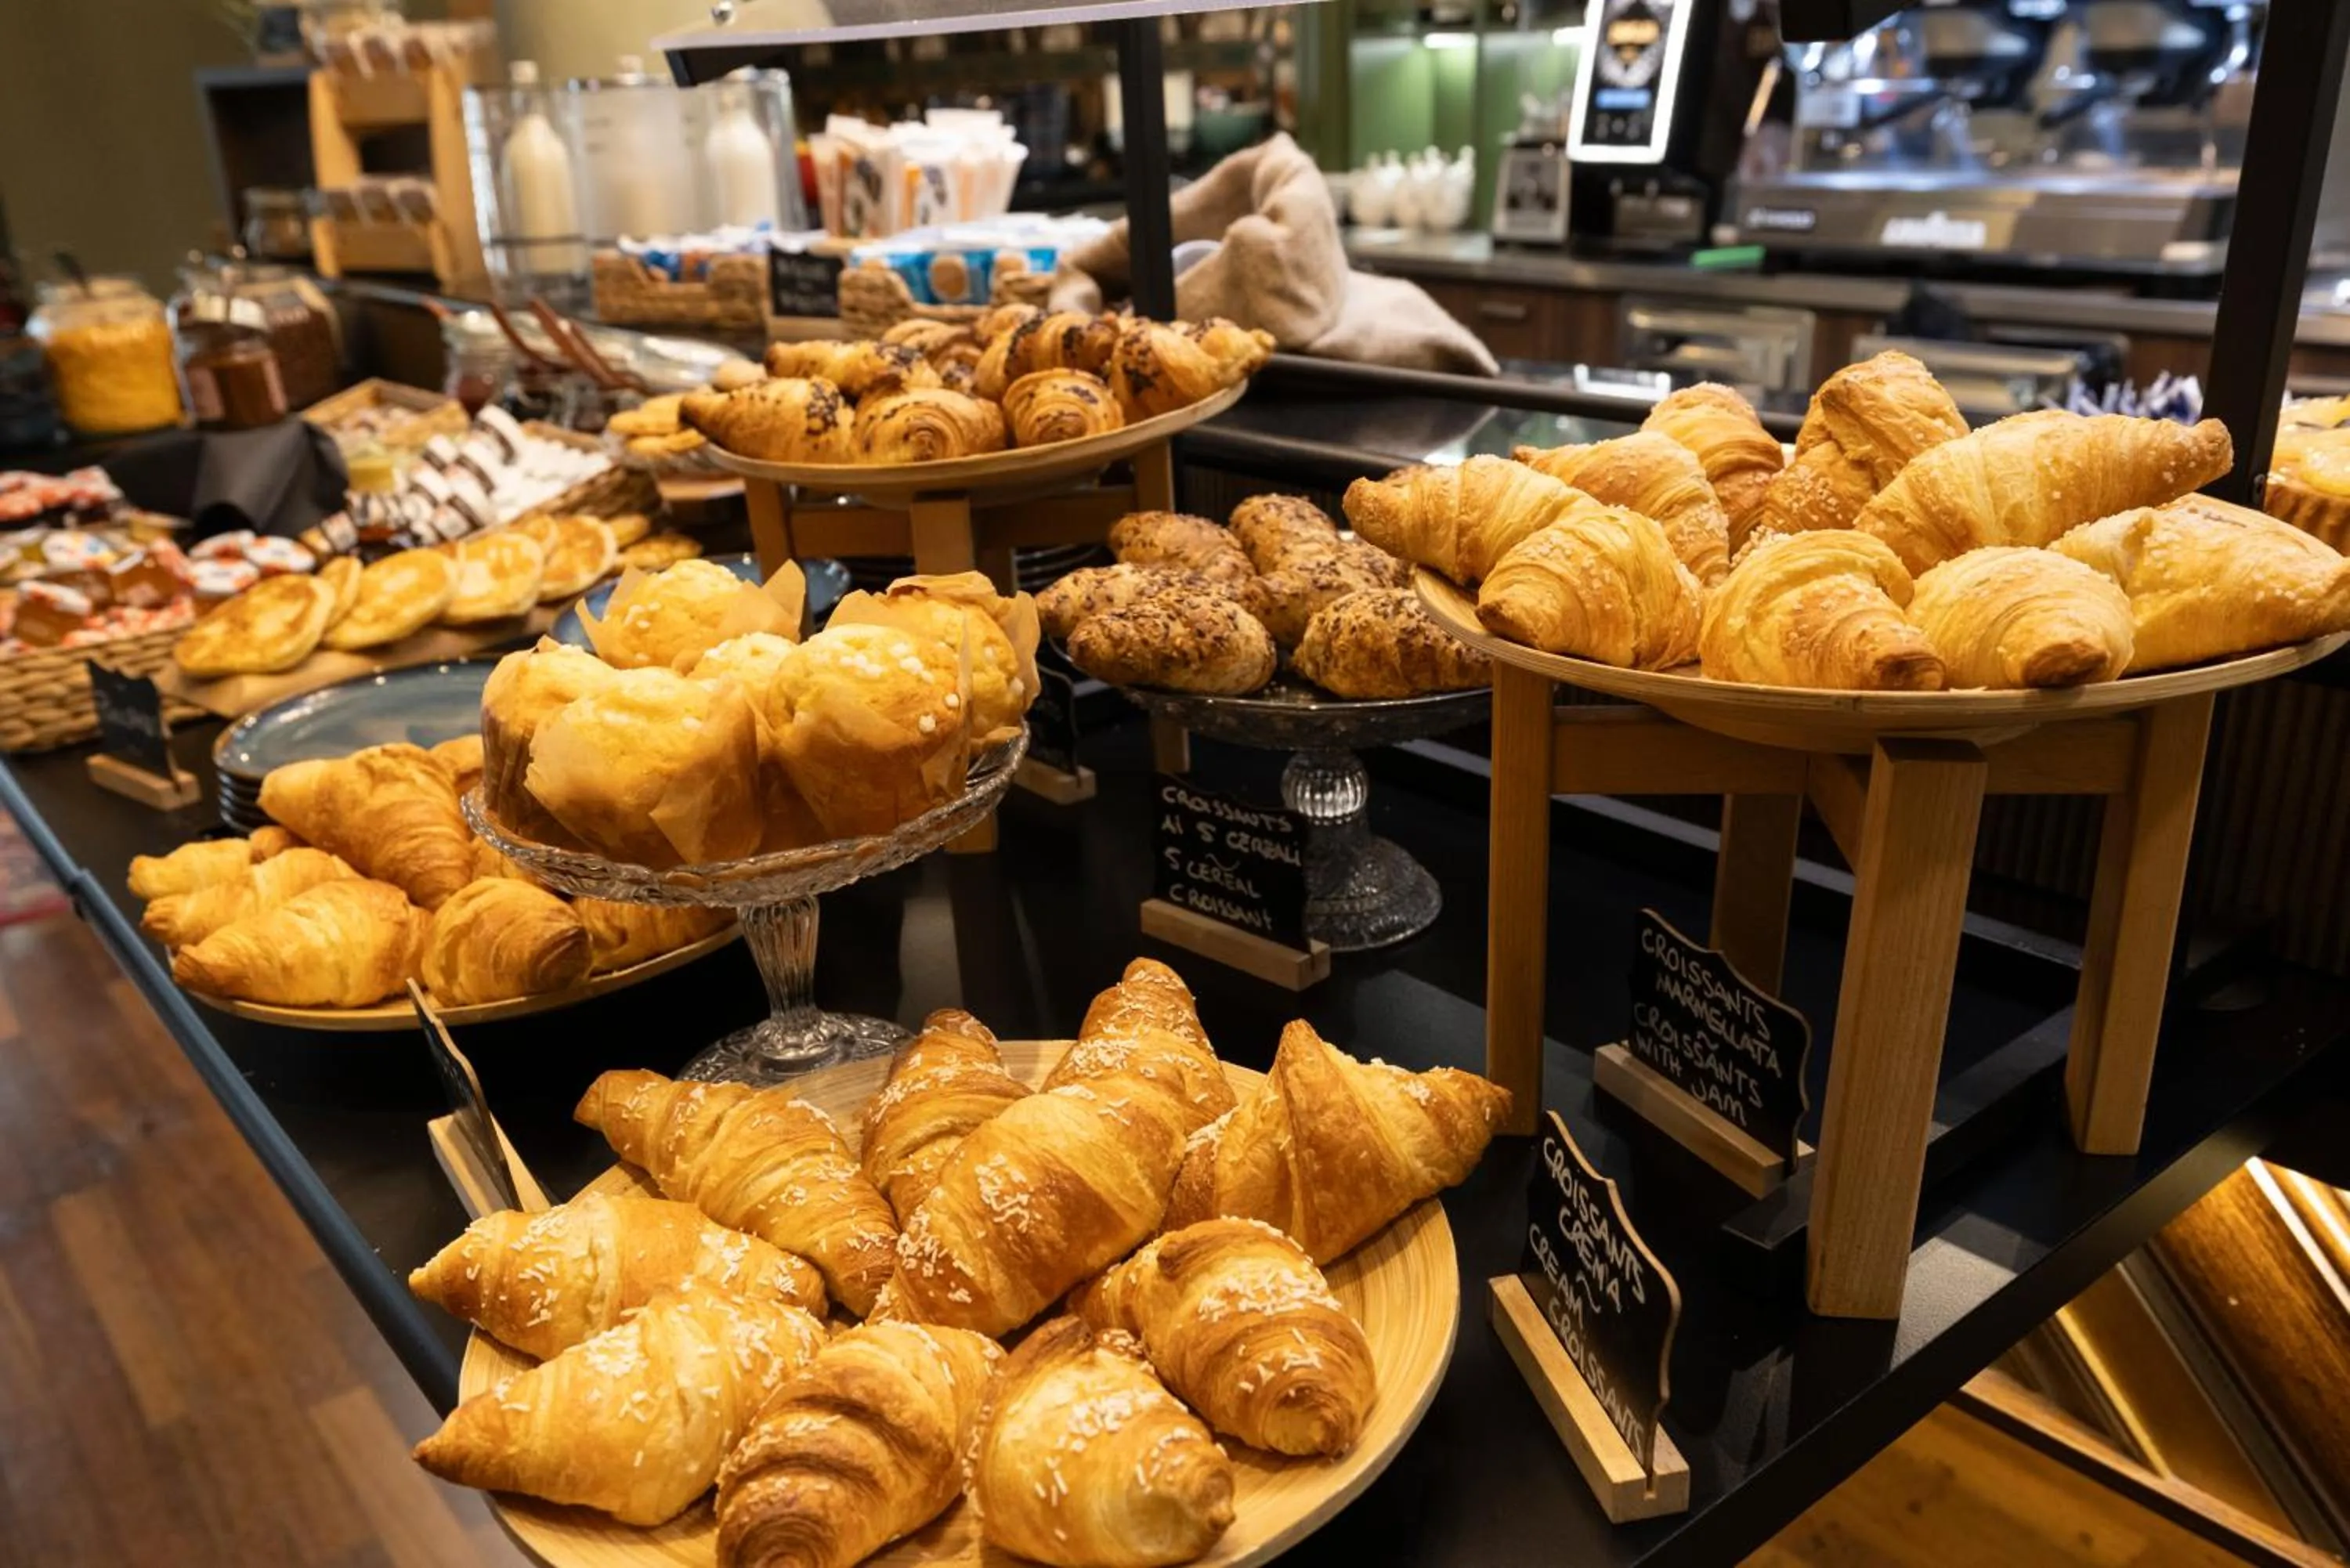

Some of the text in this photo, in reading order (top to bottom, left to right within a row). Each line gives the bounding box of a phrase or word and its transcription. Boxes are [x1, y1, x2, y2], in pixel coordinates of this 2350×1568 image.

[1161, 814, 1184, 836] AI
[1225, 830, 1303, 867] CEREALI
[1186, 860, 1263, 899] CEREAL
[1641, 927, 1772, 1041] CROISSANTS
[1657, 974, 1782, 1079] MARMELLATA
[1634, 1003, 1763, 1109] CROISSANTS
[1636, 1030, 1747, 1127] WITH JAM
[1543, 1136, 1645, 1304] CROISSANTS
[1559, 1205, 1622, 1314] CREMA
[1530, 1223, 1584, 1330] CREAM
[1549, 1295, 1644, 1454] CROISSANTS
